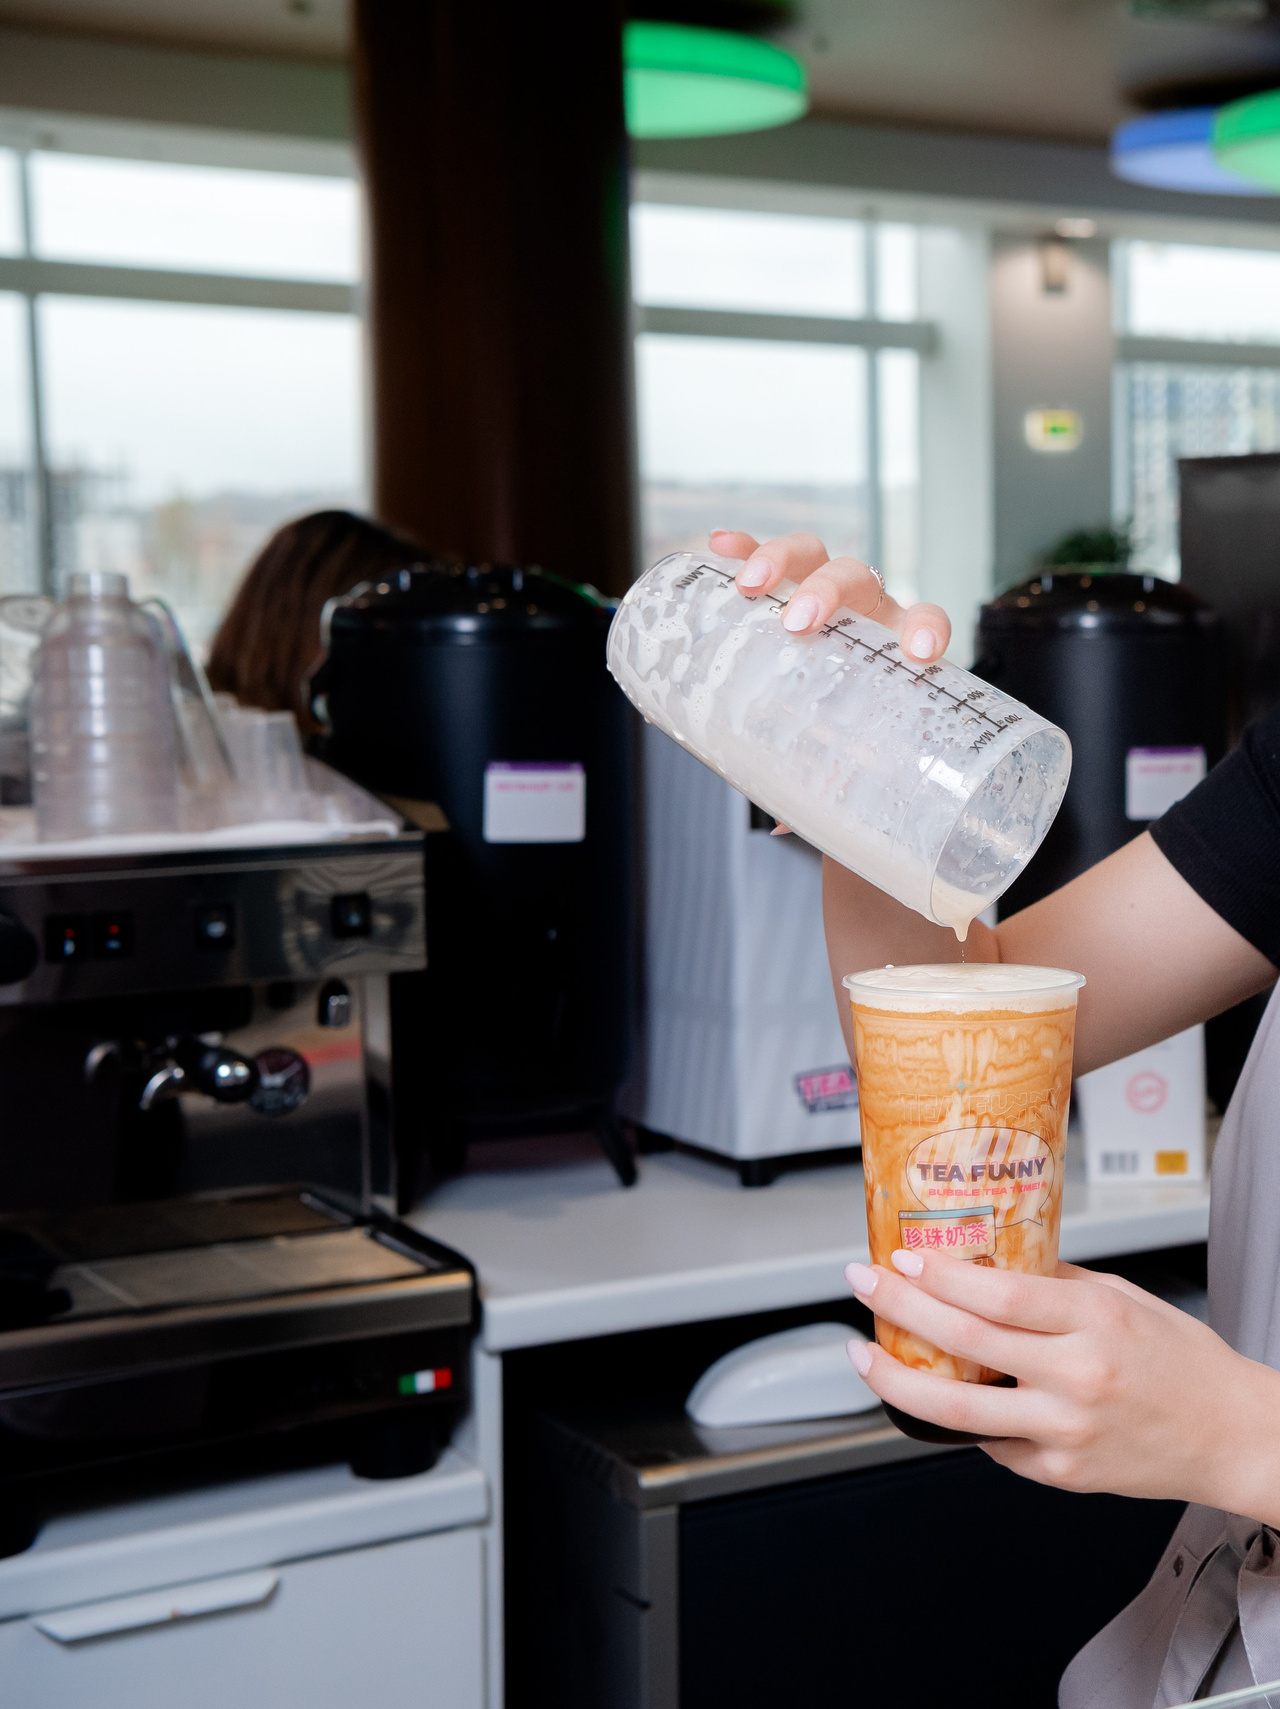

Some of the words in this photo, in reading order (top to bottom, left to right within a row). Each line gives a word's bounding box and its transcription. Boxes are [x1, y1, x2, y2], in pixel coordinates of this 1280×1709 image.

[675, 569, 704, 590] MIN
[819, 630, 831, 638] E
[844, 642, 854, 651] F
[882, 641, 900, 651] 400
[863, 654, 876, 664] G
[883, 665, 897, 675] H
[924, 664, 944, 675] 500
[948, 704, 961, 714] K
[1003, 713, 1023, 724] 700
[969, 729, 996, 754] MAX
[917, 1162, 966, 1182] TEA
[971, 1157, 1047, 1182] FUNNY
[928, 1187, 980, 1197] BUBBLE
[983, 1187, 1008, 1196] TEA
[904, 1222, 989, 1249] 珍珠奶茶
